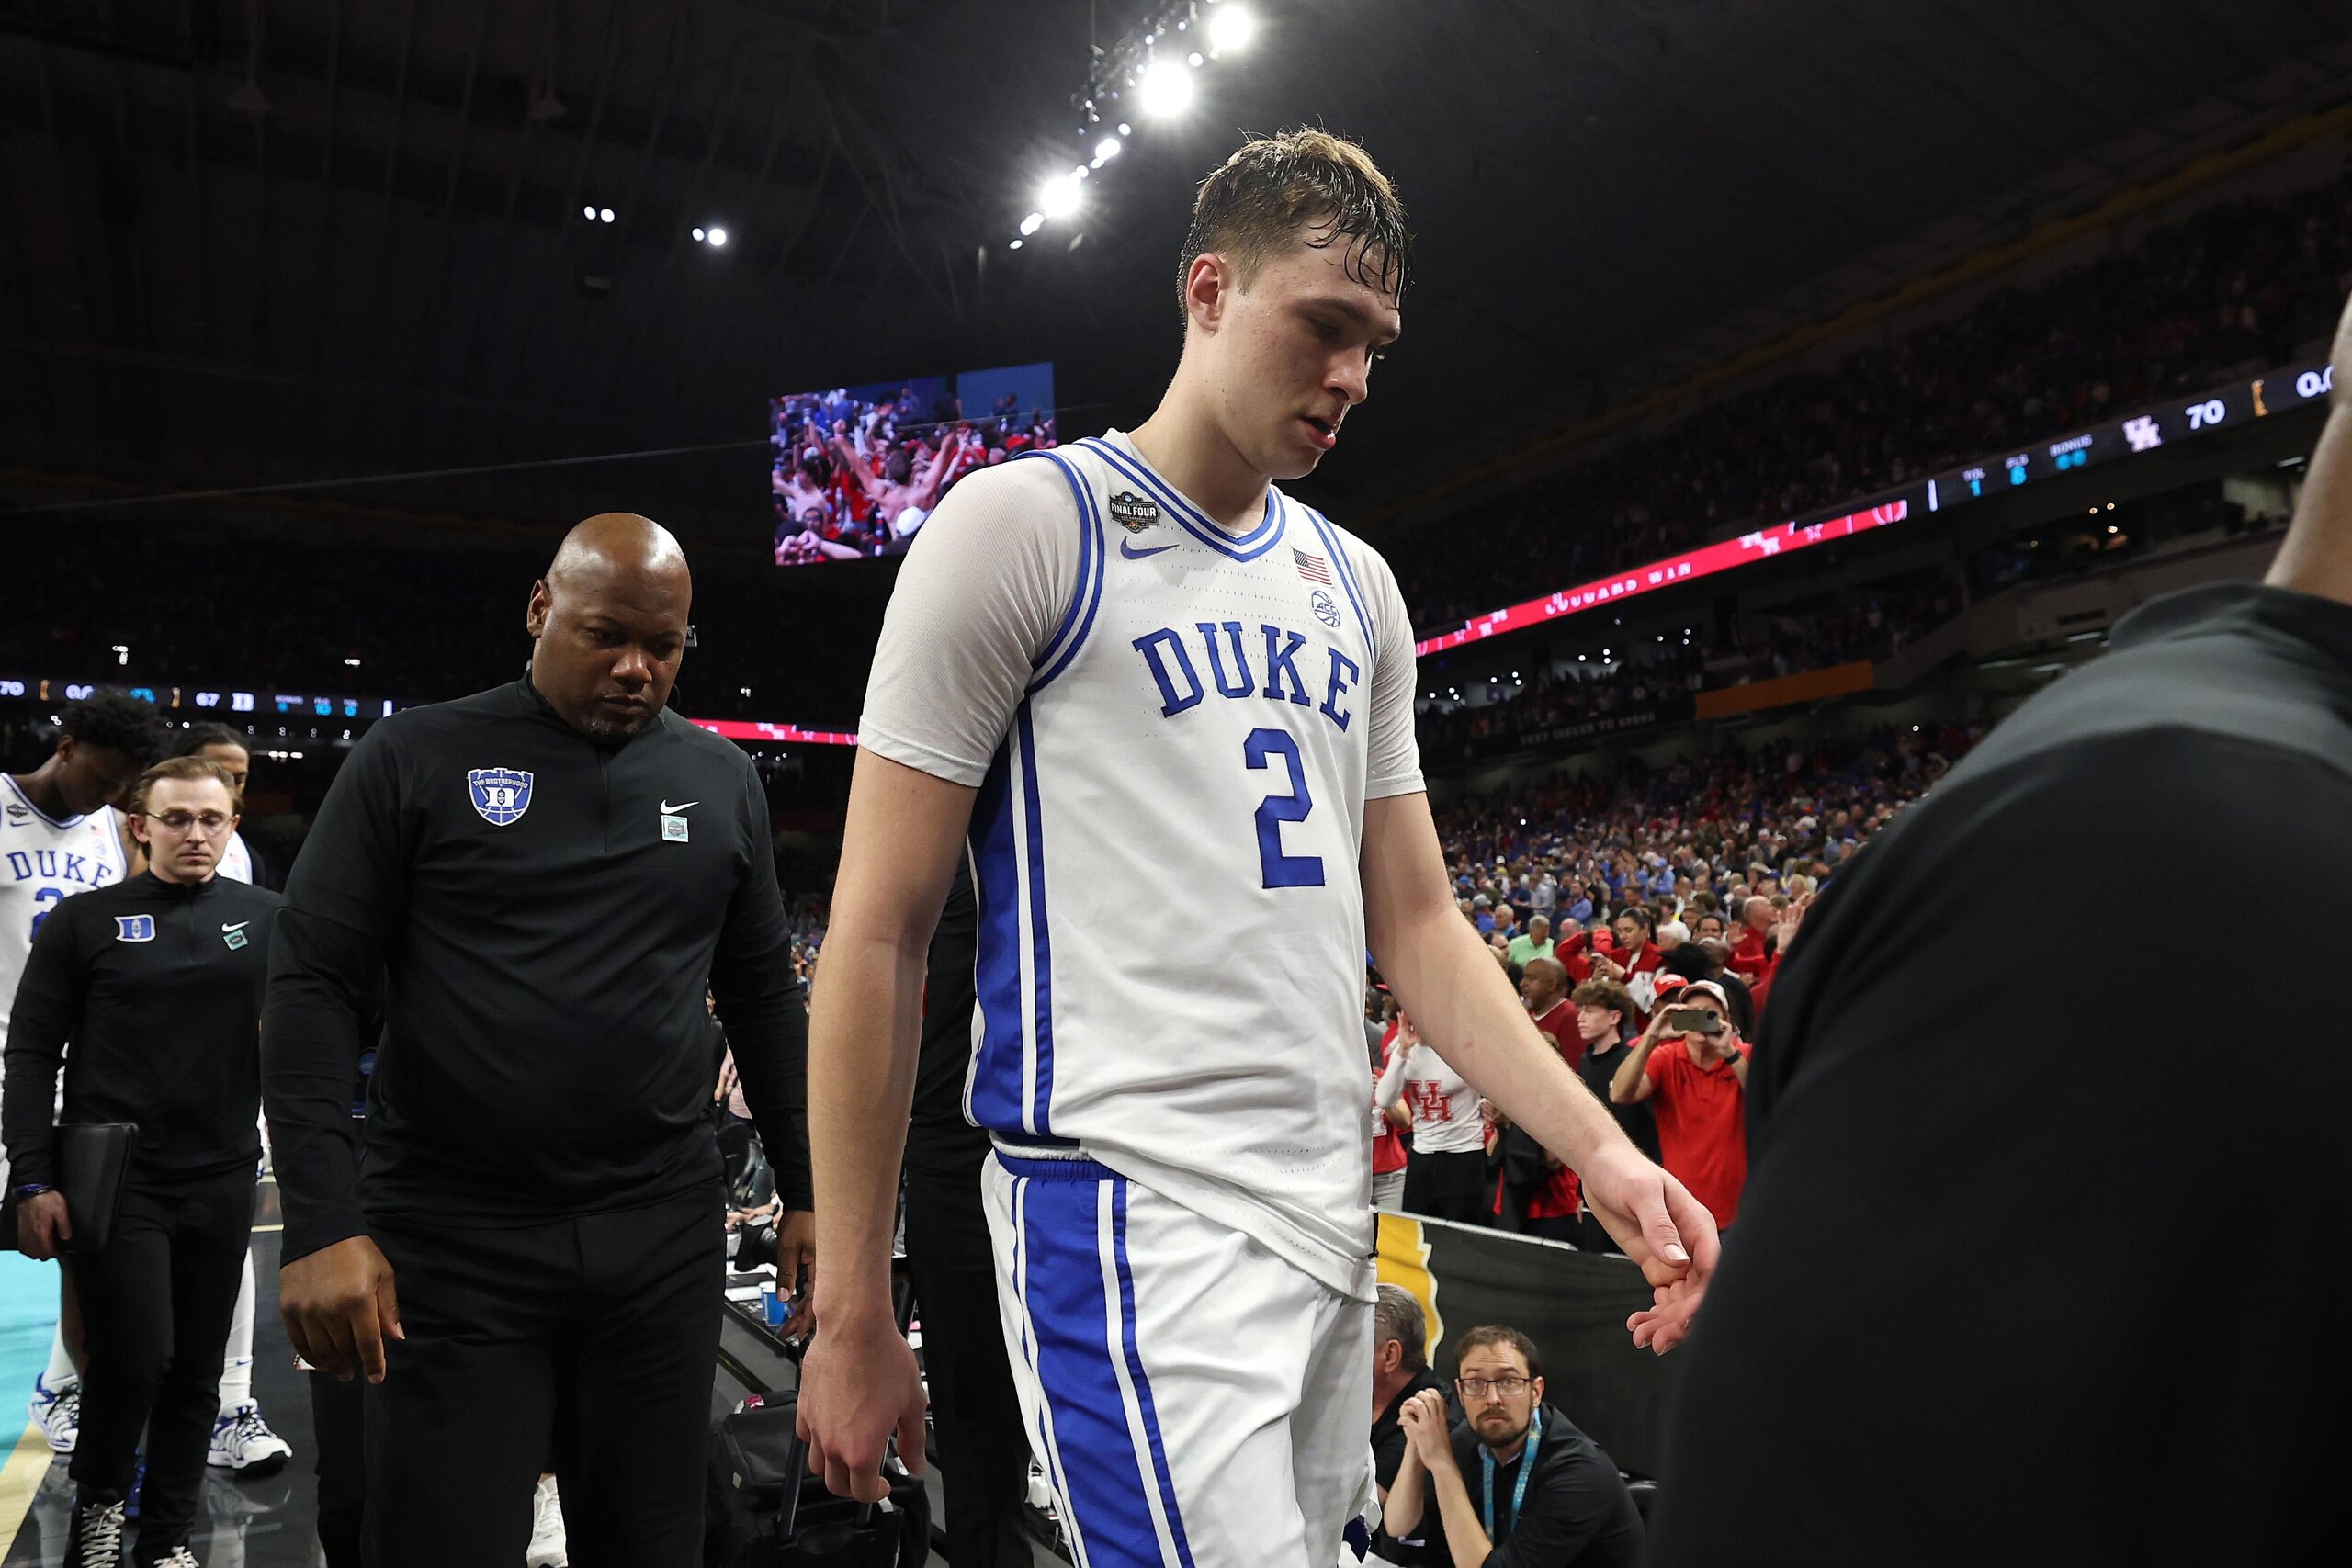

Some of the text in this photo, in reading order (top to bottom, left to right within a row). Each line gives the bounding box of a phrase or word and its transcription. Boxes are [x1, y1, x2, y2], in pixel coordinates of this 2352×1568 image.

[2185, 399, 2225, 430] 70
[1969, 479, 1982, 497] 1
[1111, 502, 1132, 515] FINAL
[1132, 505, 1157, 517] FOUR
[1316, 602, 1338, 616] ACC
[1132, 621, 1360, 733] DUKE
[195, 692, 220, 707] 67
[472, 778, 529, 789] THE BROTHERHOOD
[1243, 728, 1325, 889] 2
[6, 850, 113, 889] DUKE
